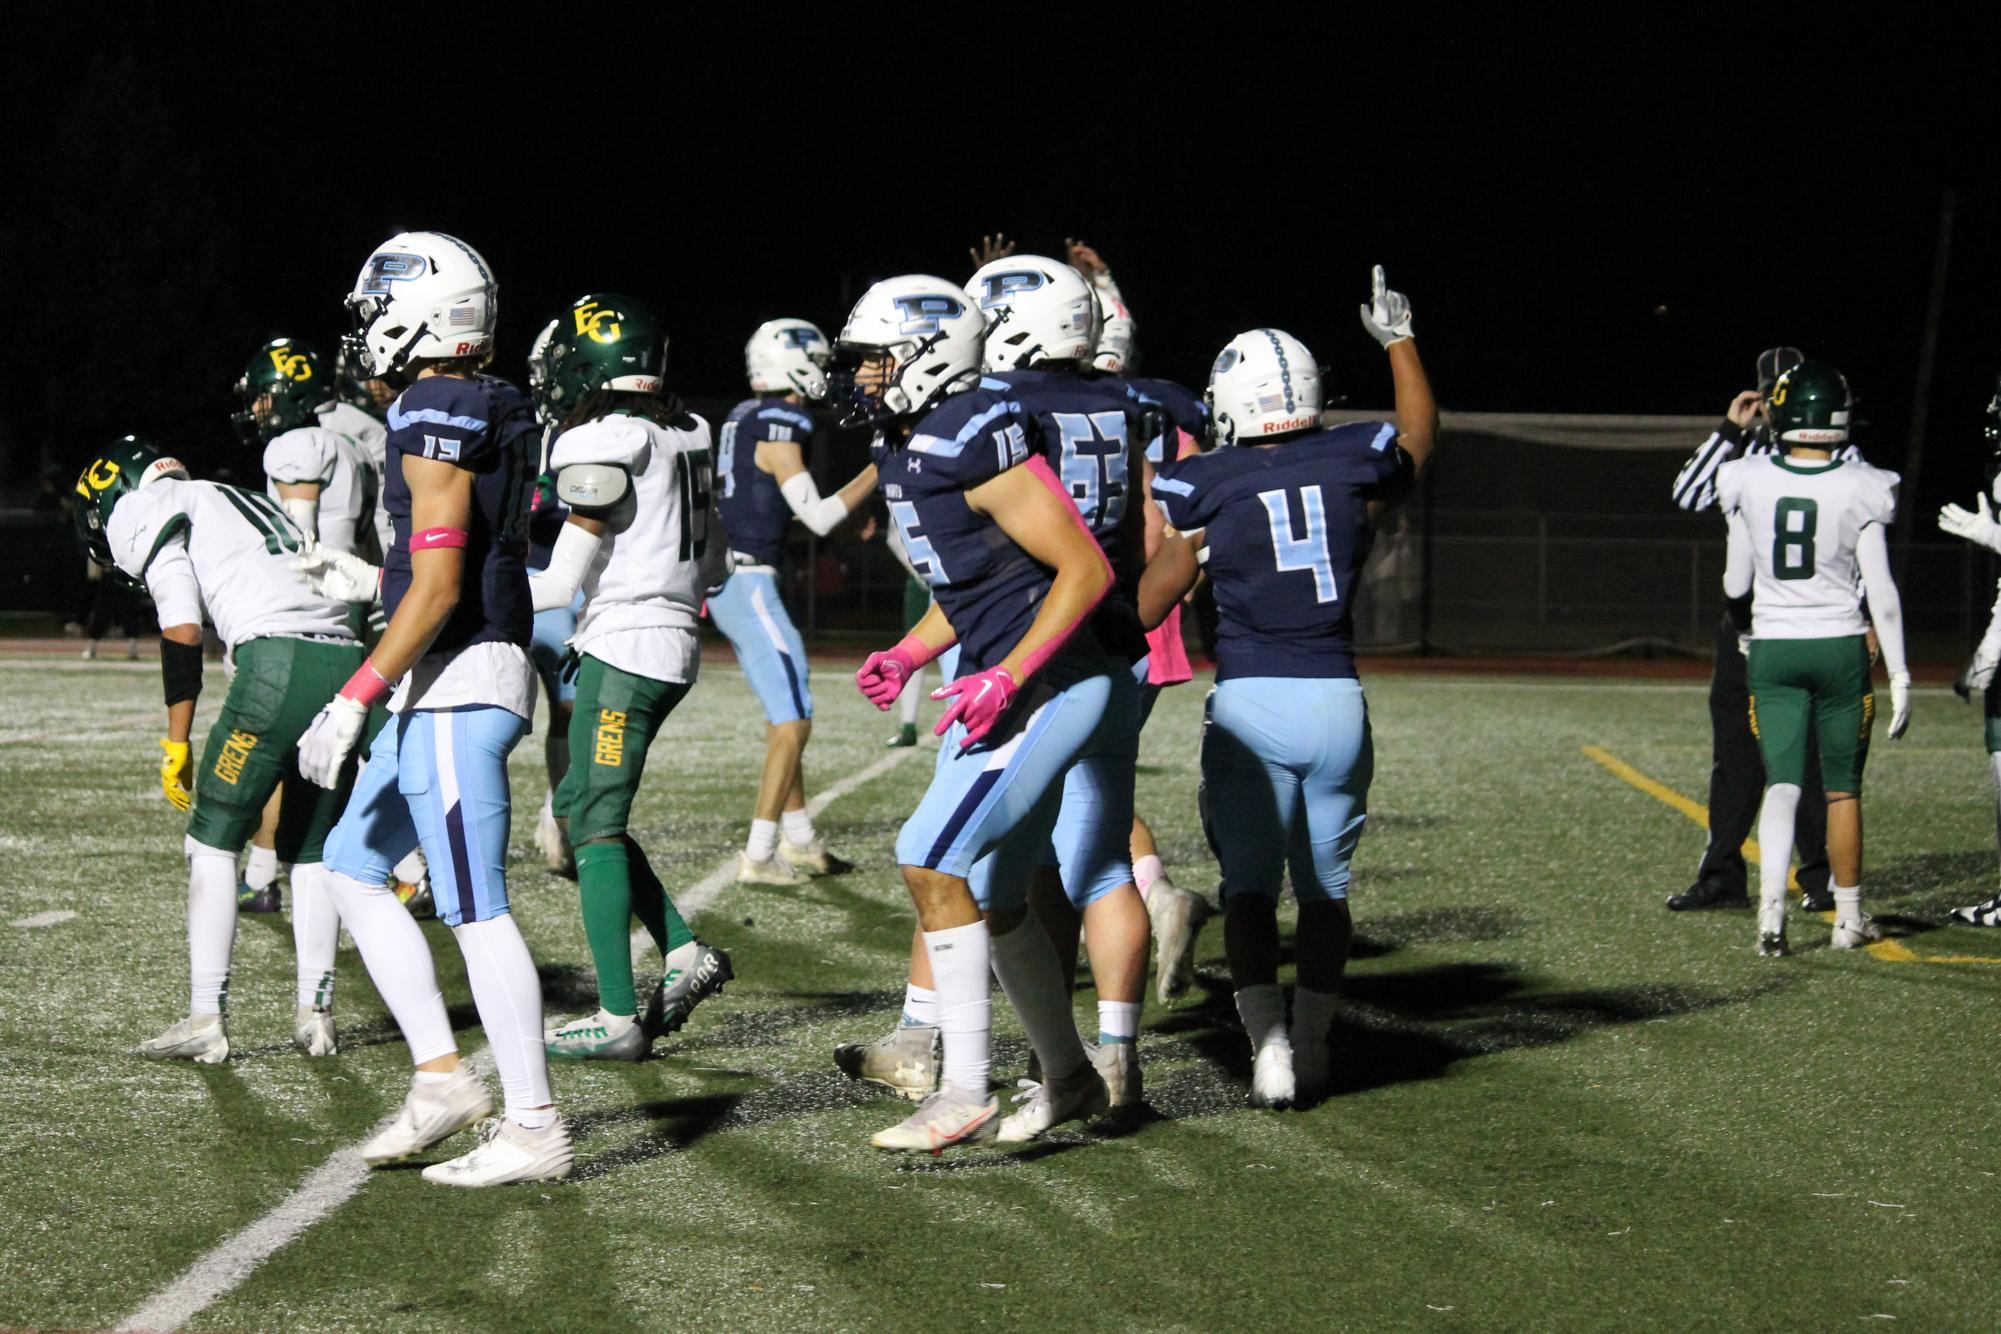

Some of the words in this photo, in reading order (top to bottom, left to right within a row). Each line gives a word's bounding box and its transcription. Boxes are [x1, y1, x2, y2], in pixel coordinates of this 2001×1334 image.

[362, 252, 426, 295] P
[981, 269, 1044, 310] P
[574, 302, 621, 344] EG
[893, 294, 963, 336] P
[1262, 415, 1320, 434] Riddell
[886, 500, 951, 585] 5
[1257, 484, 1338, 604] 4
[1772, 495, 1818, 581] 8
